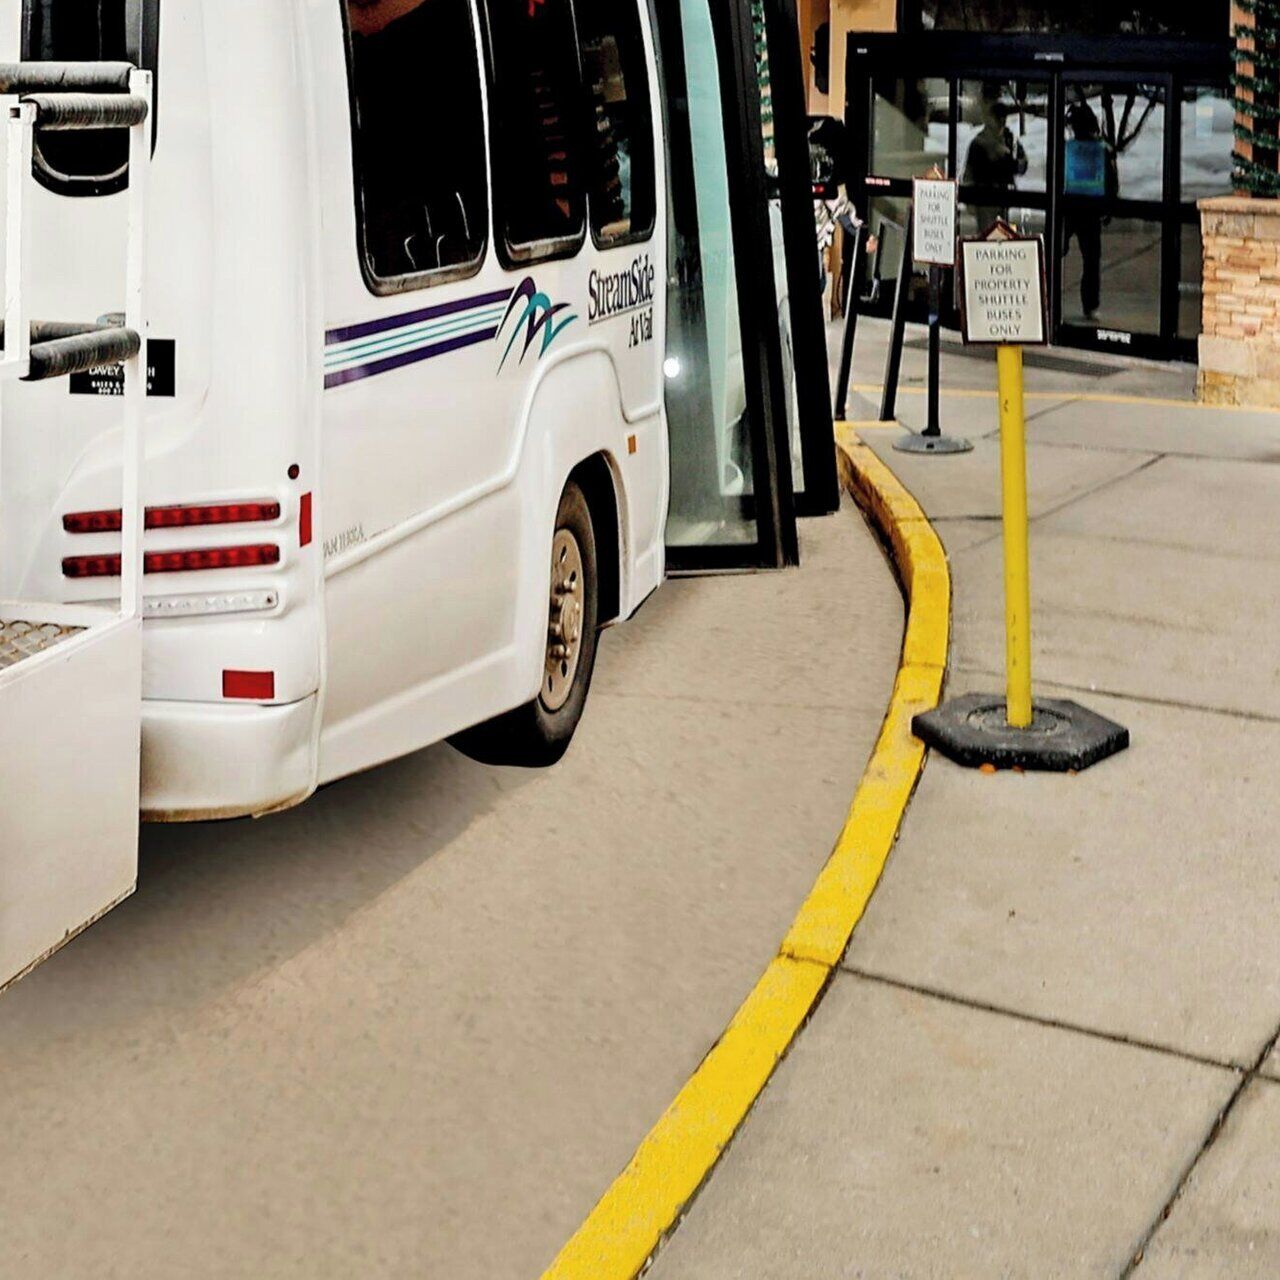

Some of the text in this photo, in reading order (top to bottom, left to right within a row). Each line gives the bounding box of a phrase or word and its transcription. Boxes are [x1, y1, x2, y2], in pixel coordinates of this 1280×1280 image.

[975, 247, 1027, 260] PARKING
[990, 263, 1013, 275] FOR
[588, 252, 655, 320] StreamSide
[974, 279, 1031, 290] PROPERTY
[978, 294, 1027, 306] SHUTTLE
[986, 309, 1022, 320] BUSES
[628, 306, 653, 349] At Vail
[989, 324, 1021, 335] ONLY
